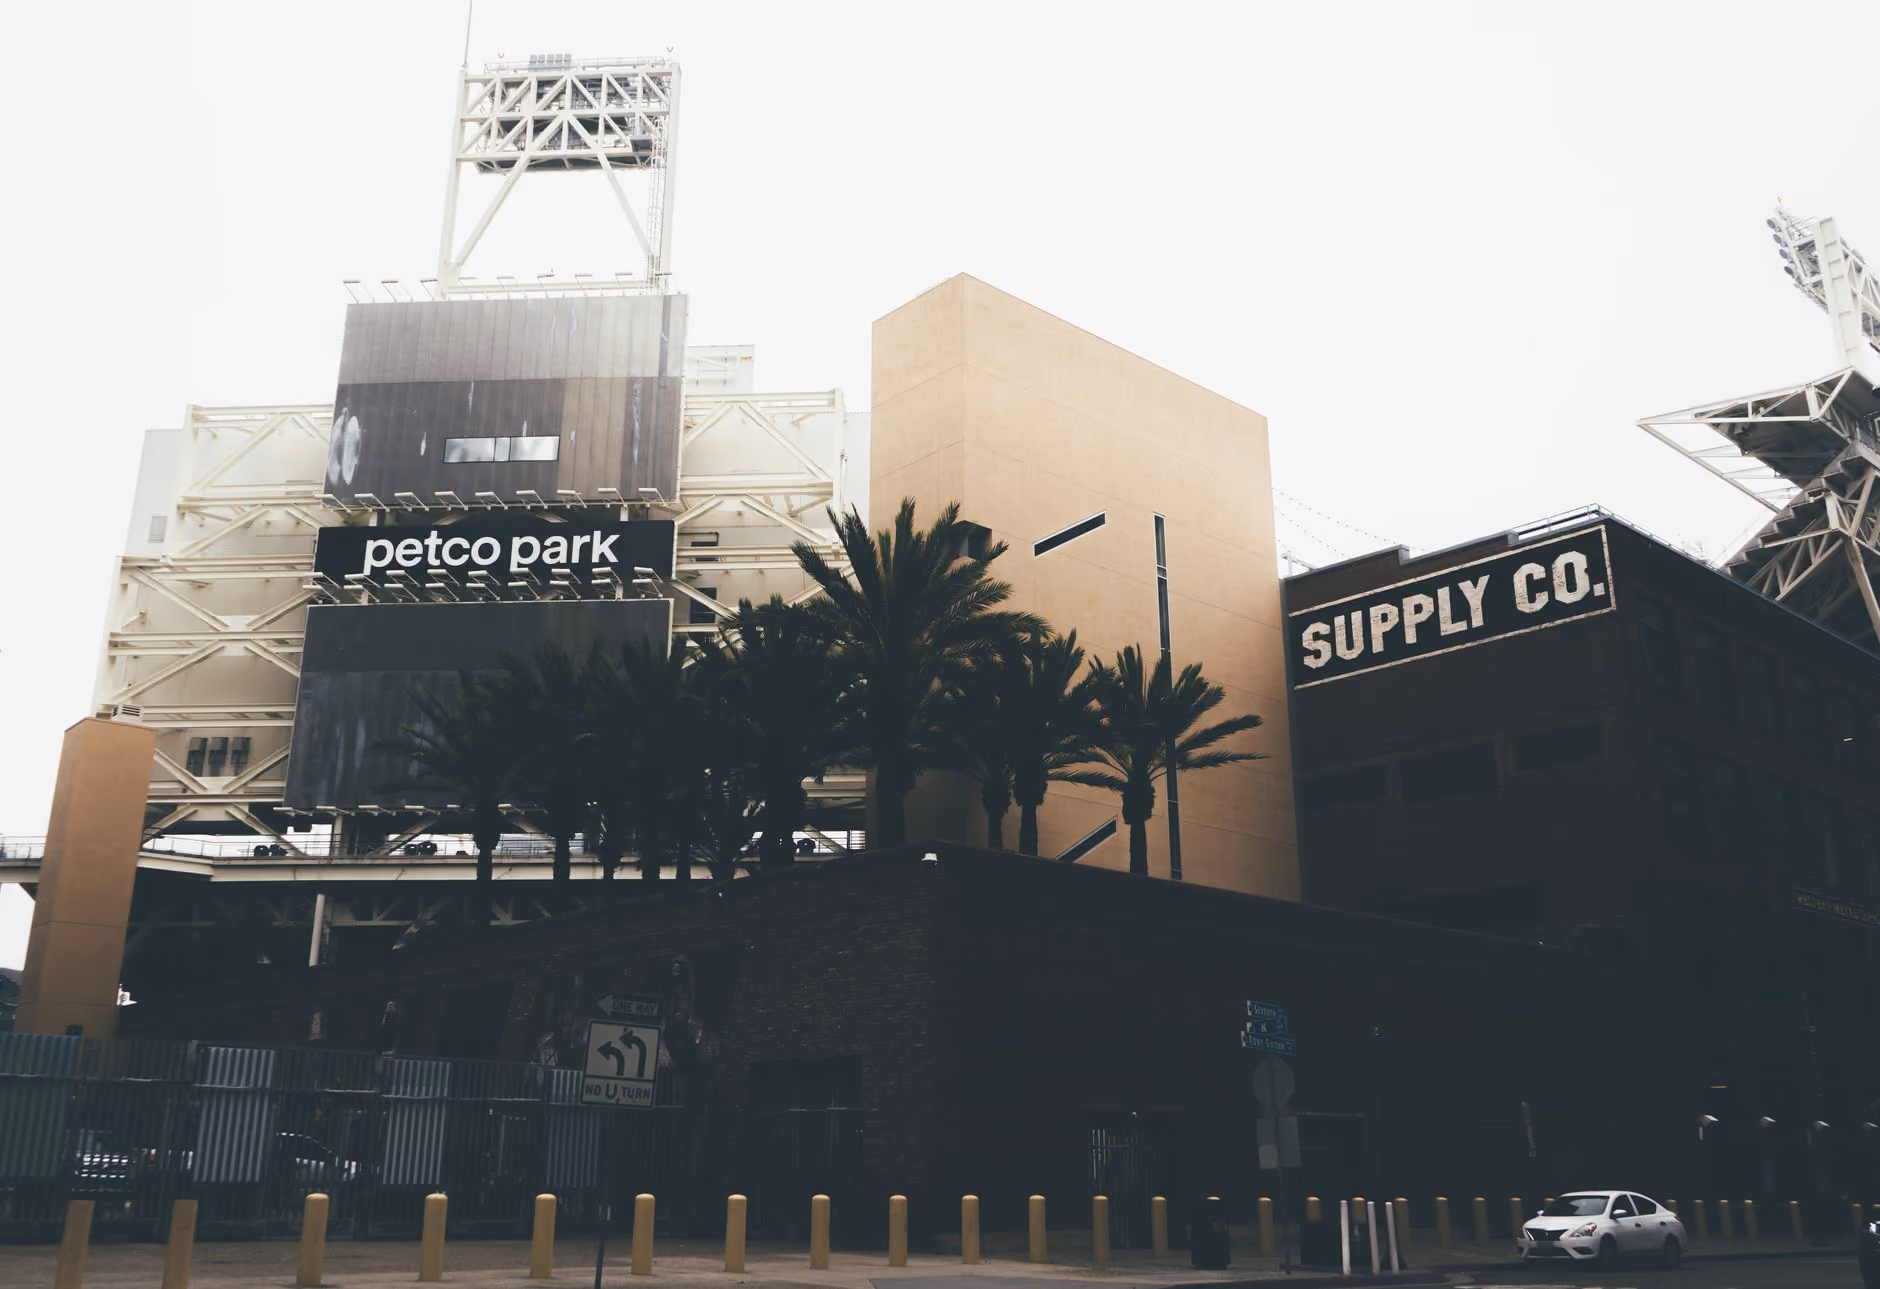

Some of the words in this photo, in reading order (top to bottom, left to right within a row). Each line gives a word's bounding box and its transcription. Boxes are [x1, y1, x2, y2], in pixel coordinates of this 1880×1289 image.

[363, 530, 501, 576] petco
[510, 530, 621, 571] park
[1301, 574, 1491, 669] SUPPLY
[1512, 550, 1606, 614] CO.
[612, 999, 634, 1013] ONE
[636, 1002, 657, 1016] WAY
[585, 1084, 602, 1097] NO
[605, 1083, 618, 1100] U
[621, 1086, 651, 1100] TURN
